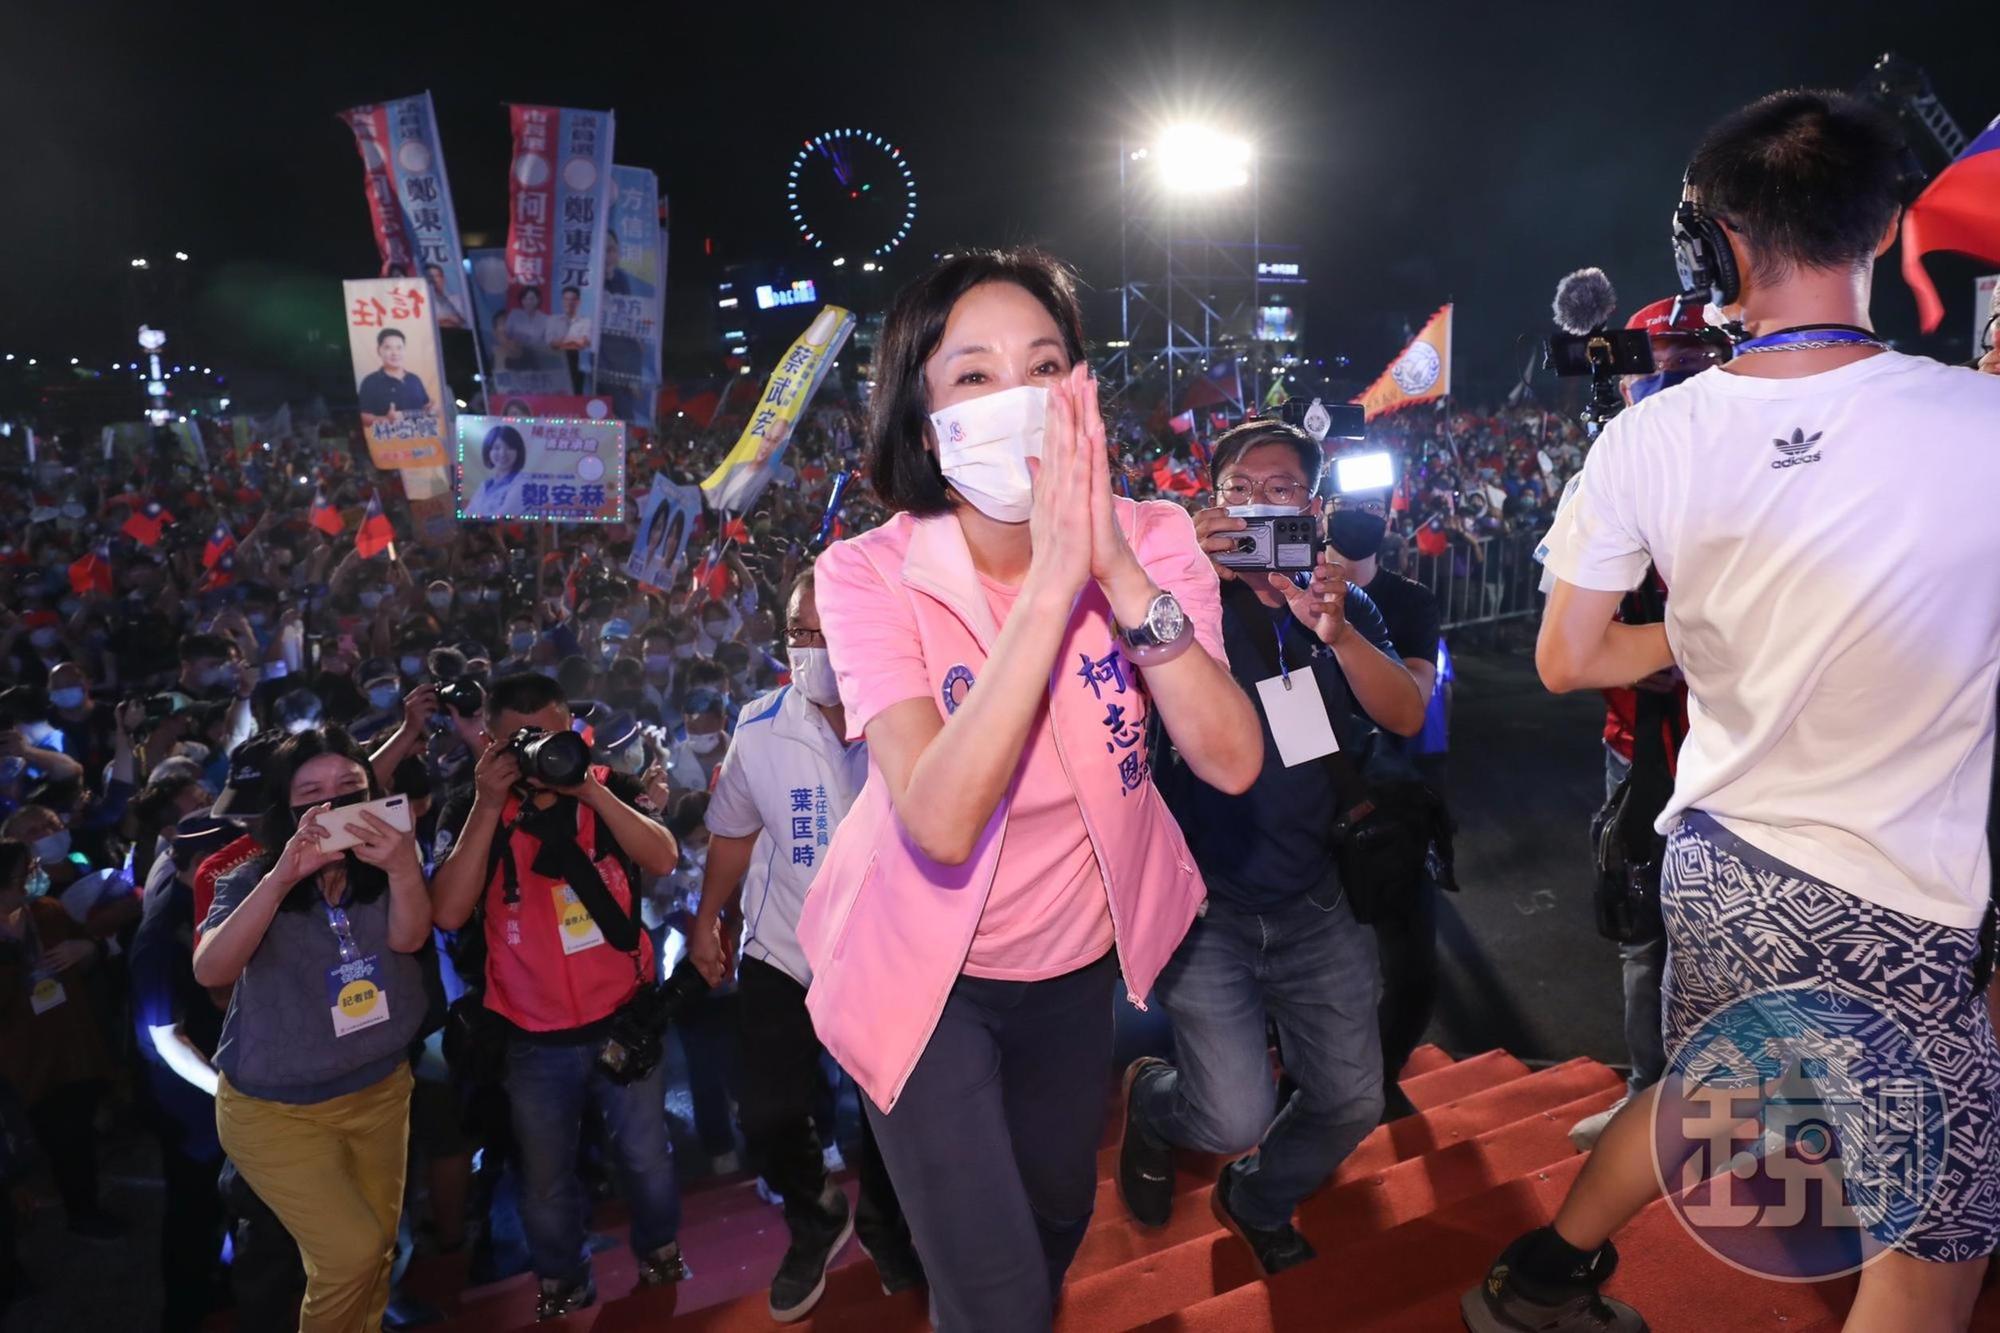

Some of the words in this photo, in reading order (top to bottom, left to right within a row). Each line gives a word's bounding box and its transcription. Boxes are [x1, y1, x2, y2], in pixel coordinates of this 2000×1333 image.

[406, 176, 448, 263] 鄭東元
[512, 191, 547, 286] 柯志恩
[561, 197, 594, 287] 鄭東元
[1645, 314, 1688, 328] Taiwn
[1771, 451, 1822, 469] adidas
[1077, 651, 1149, 797] 柯志恩
[791, 787, 816, 868] 葉匡時
[815, 784, 829, 847] 主任委員
